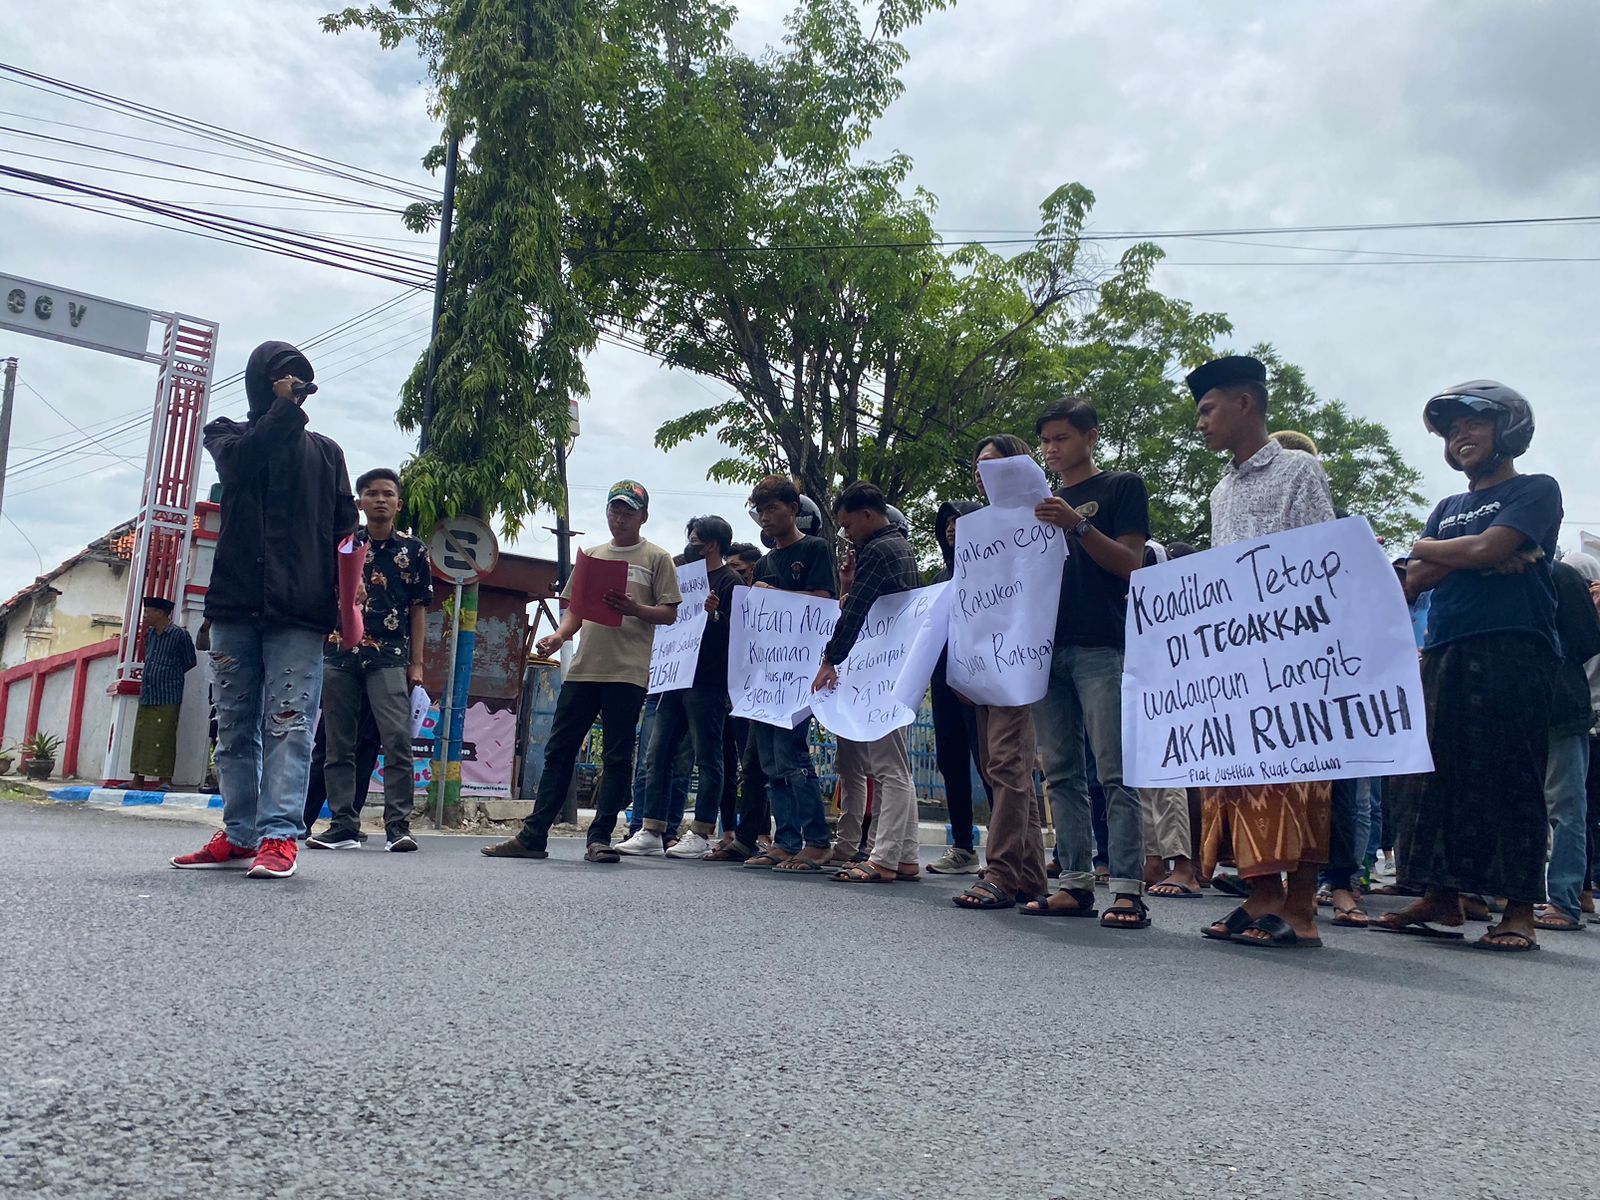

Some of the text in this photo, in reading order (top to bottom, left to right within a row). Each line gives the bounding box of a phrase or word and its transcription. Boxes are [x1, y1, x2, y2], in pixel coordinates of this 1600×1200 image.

[1166, 595, 1331, 668] DI TEGAKKAN
[1262, 640, 1362, 695] Langit
[1161, 685, 1412, 768] AKAN RUNTUH
